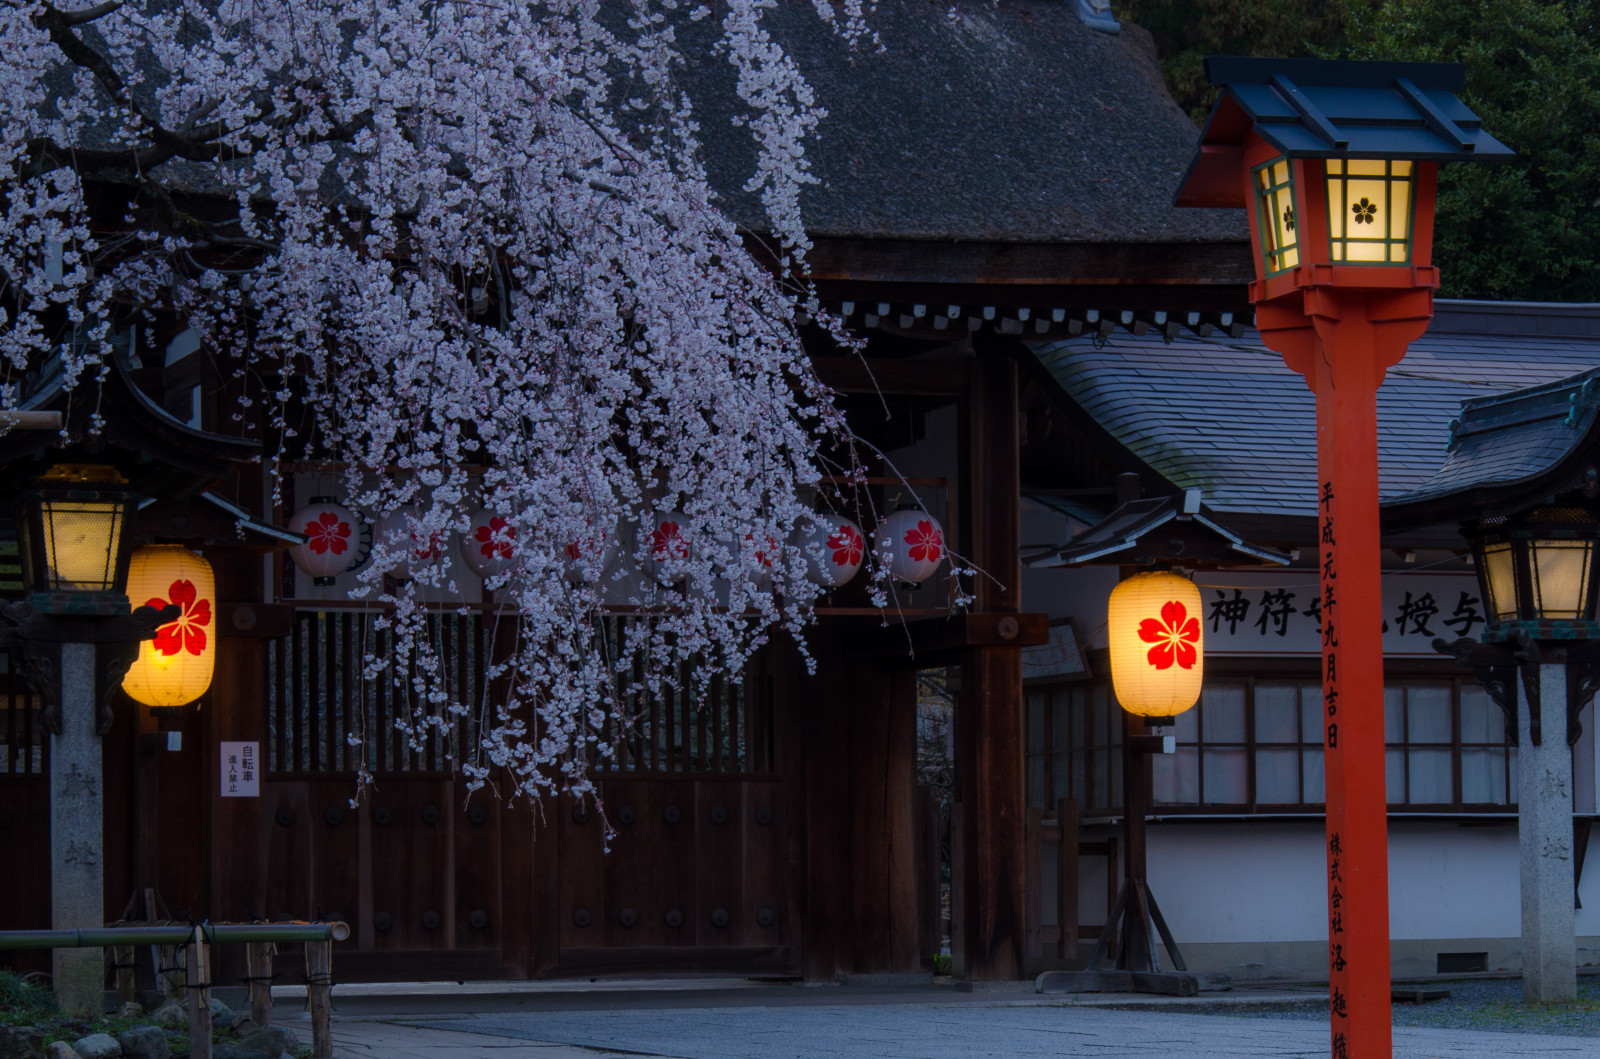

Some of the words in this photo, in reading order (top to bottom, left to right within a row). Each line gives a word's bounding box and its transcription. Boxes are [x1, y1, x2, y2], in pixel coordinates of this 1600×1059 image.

[1207, 588, 1485, 637] 神符授与
[1321, 482, 1338, 749] 平成元年九月吉日
[228, 754, 238, 792] 進入禁止
[242, 745, 254, 783] 自転車
